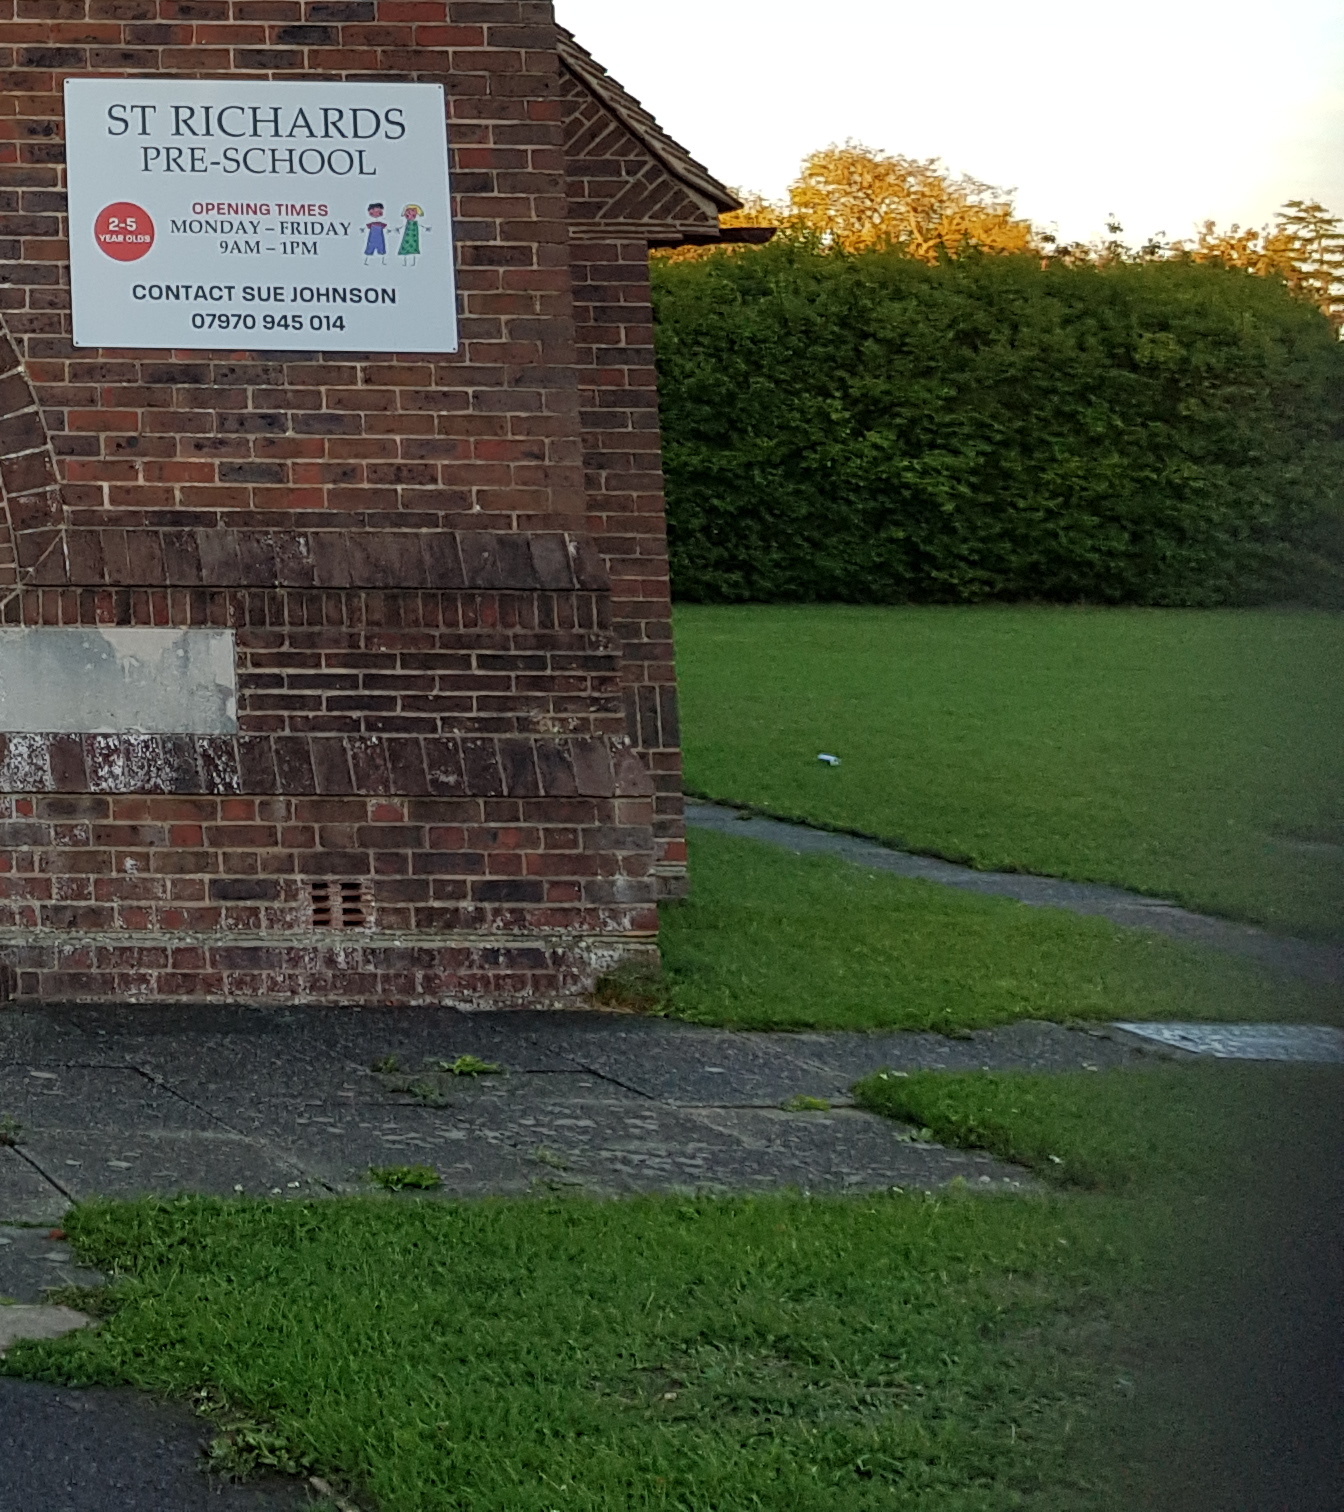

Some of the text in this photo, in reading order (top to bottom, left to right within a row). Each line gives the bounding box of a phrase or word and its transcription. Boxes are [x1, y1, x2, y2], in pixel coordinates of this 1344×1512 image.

[107, 104, 406, 140] ST RICHARDS
[140, 146, 377, 176] PRE-SCHOOL
[192, 202, 329, 216] OPENING TIMES
[108, 217, 137, 231] 2-5
[170, 219, 261, 235] MONDAY
[279, 221, 351, 236] FRIDAY
[98, 234, 151, 243] YEAR OLDS
[219, 240, 261, 254] 9AM
[280, 241, 319, 255] 1PM
[132, 284, 396, 304] CONTACT SUE JOHNSON
[191, 313, 346, 331] 07970 945 014
